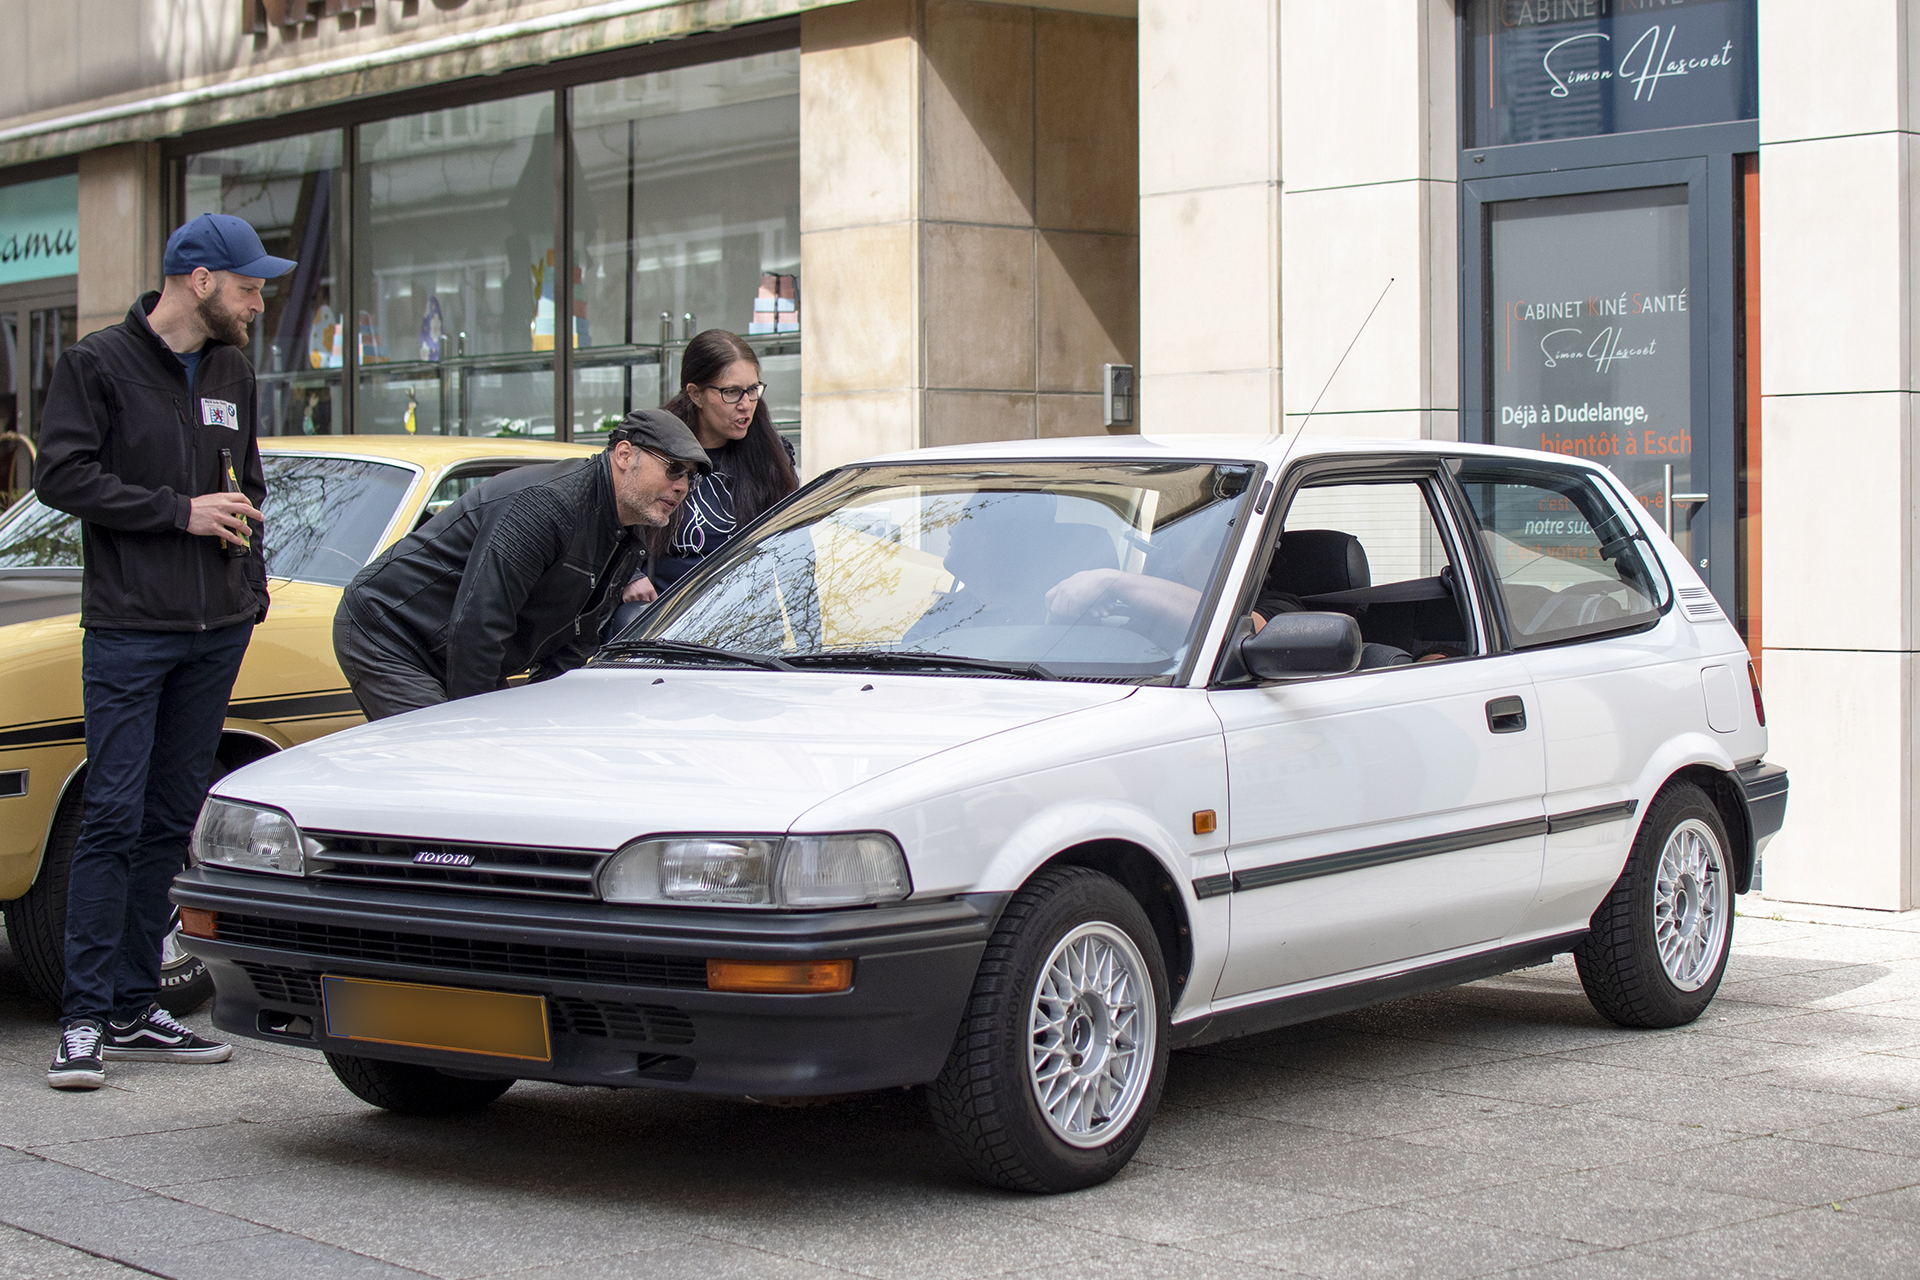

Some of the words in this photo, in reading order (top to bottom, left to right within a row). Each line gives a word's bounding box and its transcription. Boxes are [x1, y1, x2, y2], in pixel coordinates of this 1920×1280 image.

[1543, 33, 1613, 97] Simon
[0, 228, 77, 264] amu
[1514, 301, 1583, 321] CABINET
[1588, 292, 1627, 316] KINÉ
[1632, 288, 1687, 314] SANTÉ
[1540, 328, 1584, 368] Simon
[1502, 405, 1537, 428] Déjà
[1541, 405, 1550, 423] à
[1554, 402, 1648, 425] Dudelange,
[1541, 432, 1619, 456] bientôt
[1625, 431, 1637, 455] à
[1644, 429, 1692, 455] Esch
[1538, 495, 1570, 511] c'est
[1524, 518, 1564, 535] notre
[1567, 520, 1595, 535] suc
[1507, 542, 1542, 559] c'est
[1546, 544, 1588, 559] votre
[418, 852, 469, 865] TOYOTA
